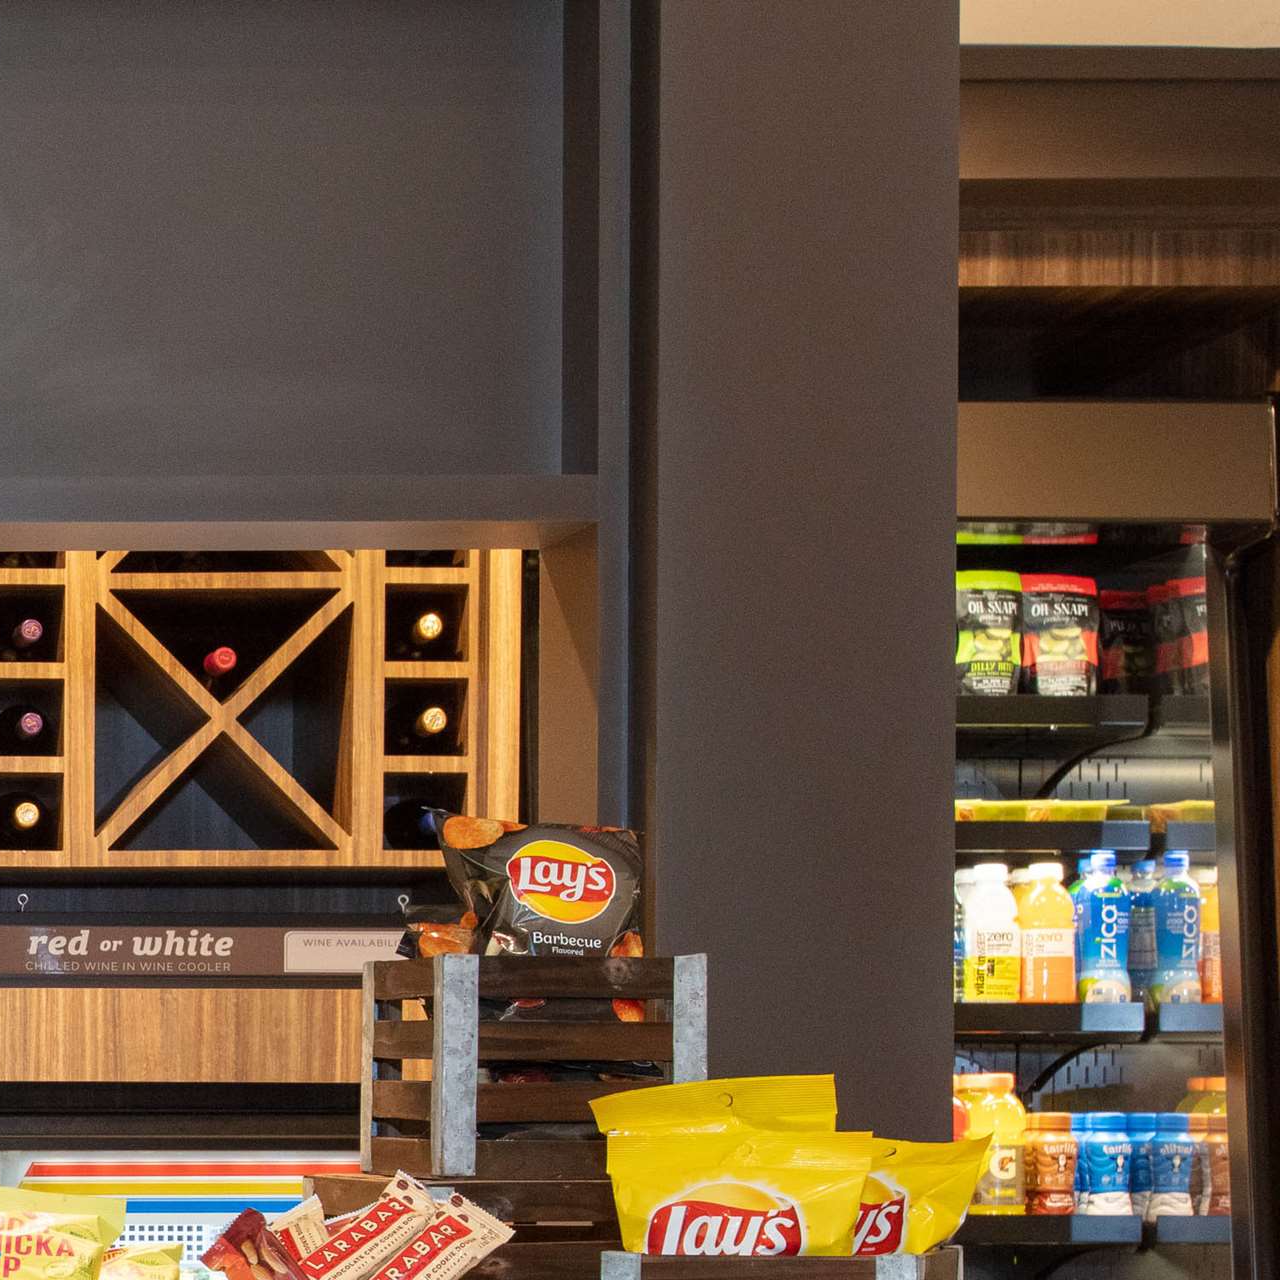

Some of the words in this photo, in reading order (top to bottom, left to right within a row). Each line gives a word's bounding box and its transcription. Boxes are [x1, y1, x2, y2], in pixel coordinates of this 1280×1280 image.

[968, 602, 984, 615] OH
[1032, 603, 1049, 616] OH
[518, 857, 607, 901] Lay's
[28, 930, 90, 956] red
[100, 939, 122, 952] or
[132, 930, 234, 957] white
[302, 938, 332, 948] WINE
[532, 931, 602, 949] Barbecue
[551, 946, 584, 956] Flavored
[25, 961, 80, 972] CHILLED
[84, 961, 119, 972] WINE
[122, 961, 137, 972] IN
[140, 961, 174, 972] WINE
[178, 961, 232, 972] COOLER
[990, 1148, 1017, 1180] G
